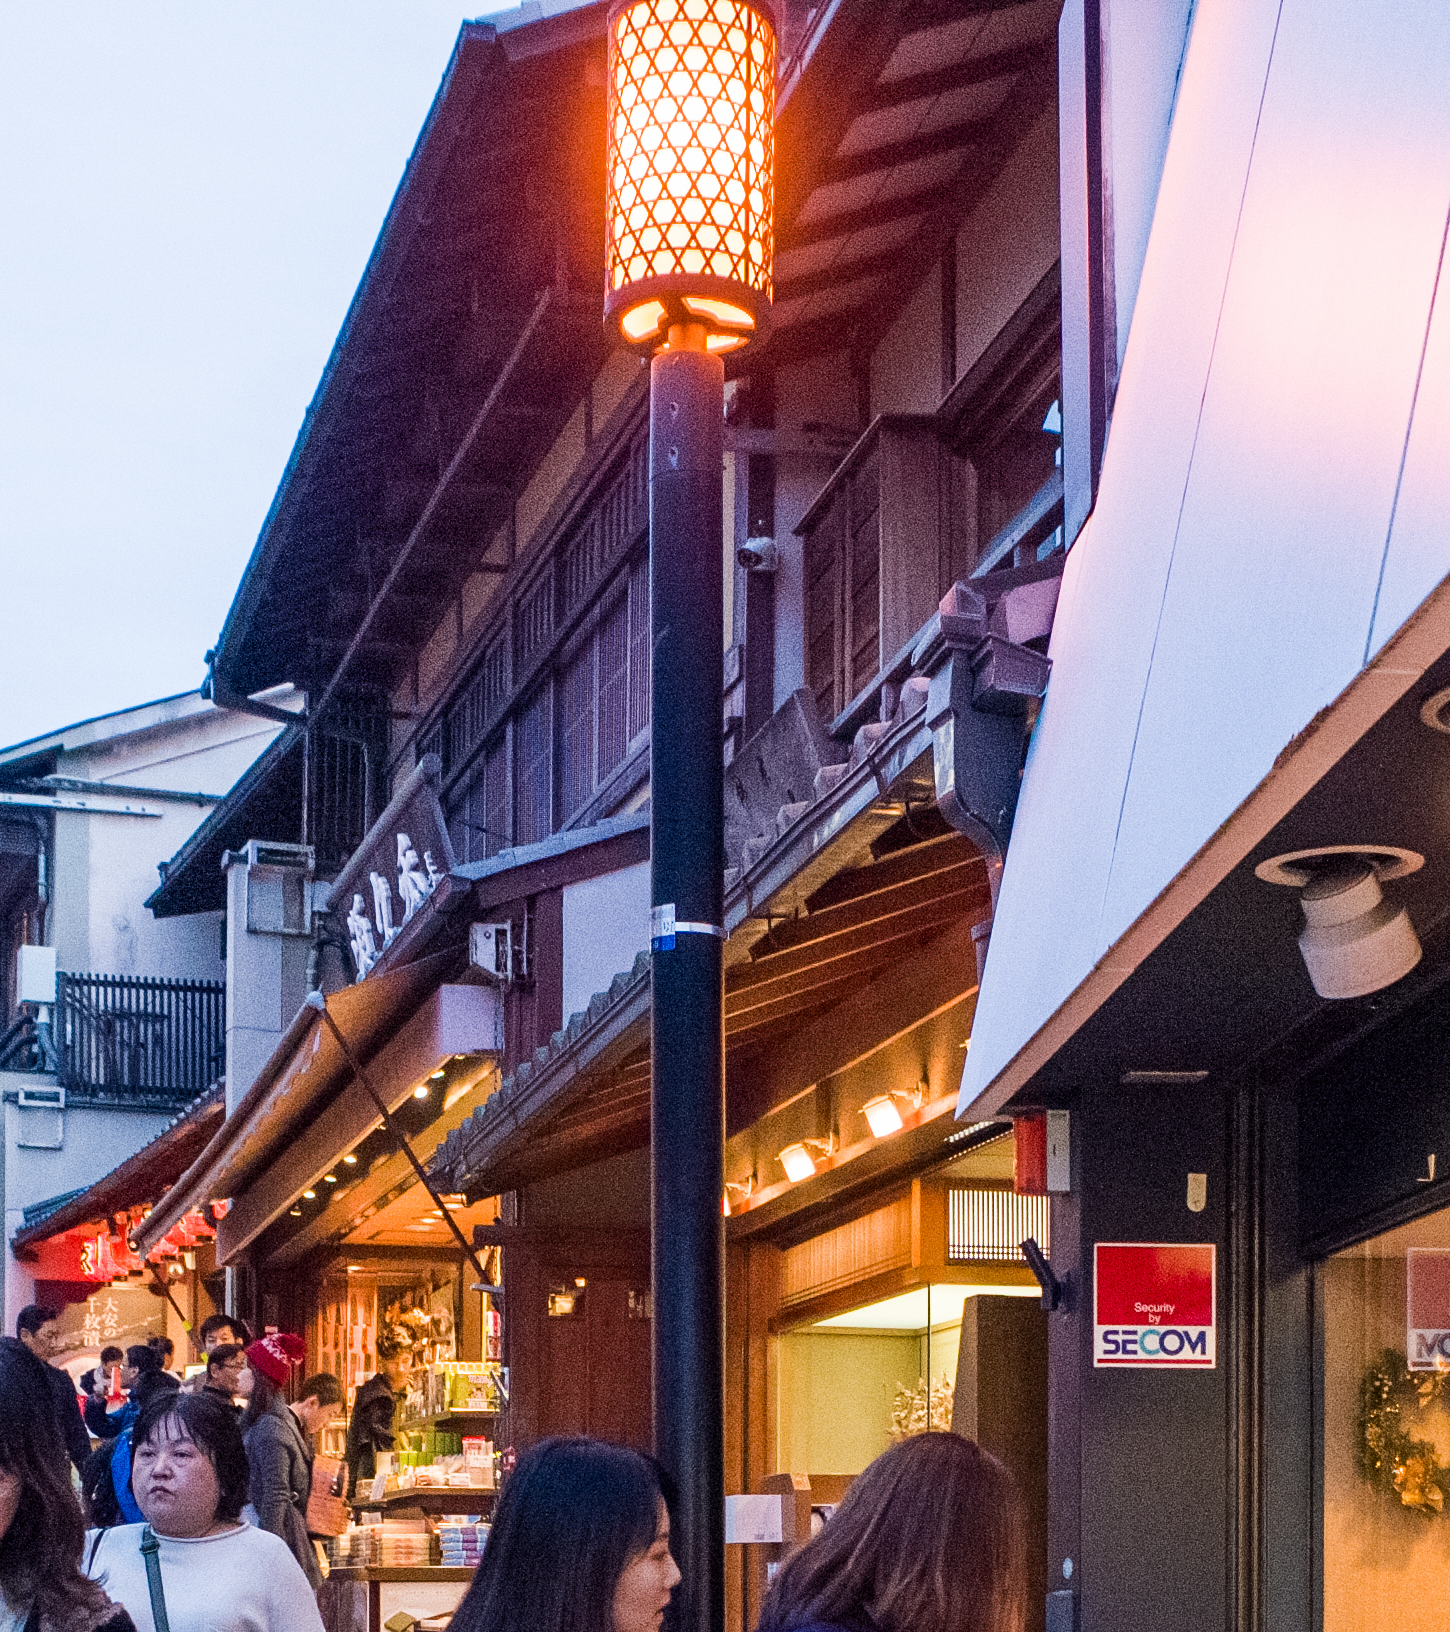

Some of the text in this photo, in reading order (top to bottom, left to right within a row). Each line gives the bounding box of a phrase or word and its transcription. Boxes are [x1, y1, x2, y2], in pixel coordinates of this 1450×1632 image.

[1133, 1302, 1176, 1315] Security
[1148, 1313, 1161, 1325] by
[1102, 1329, 1207, 1356] SECOM
